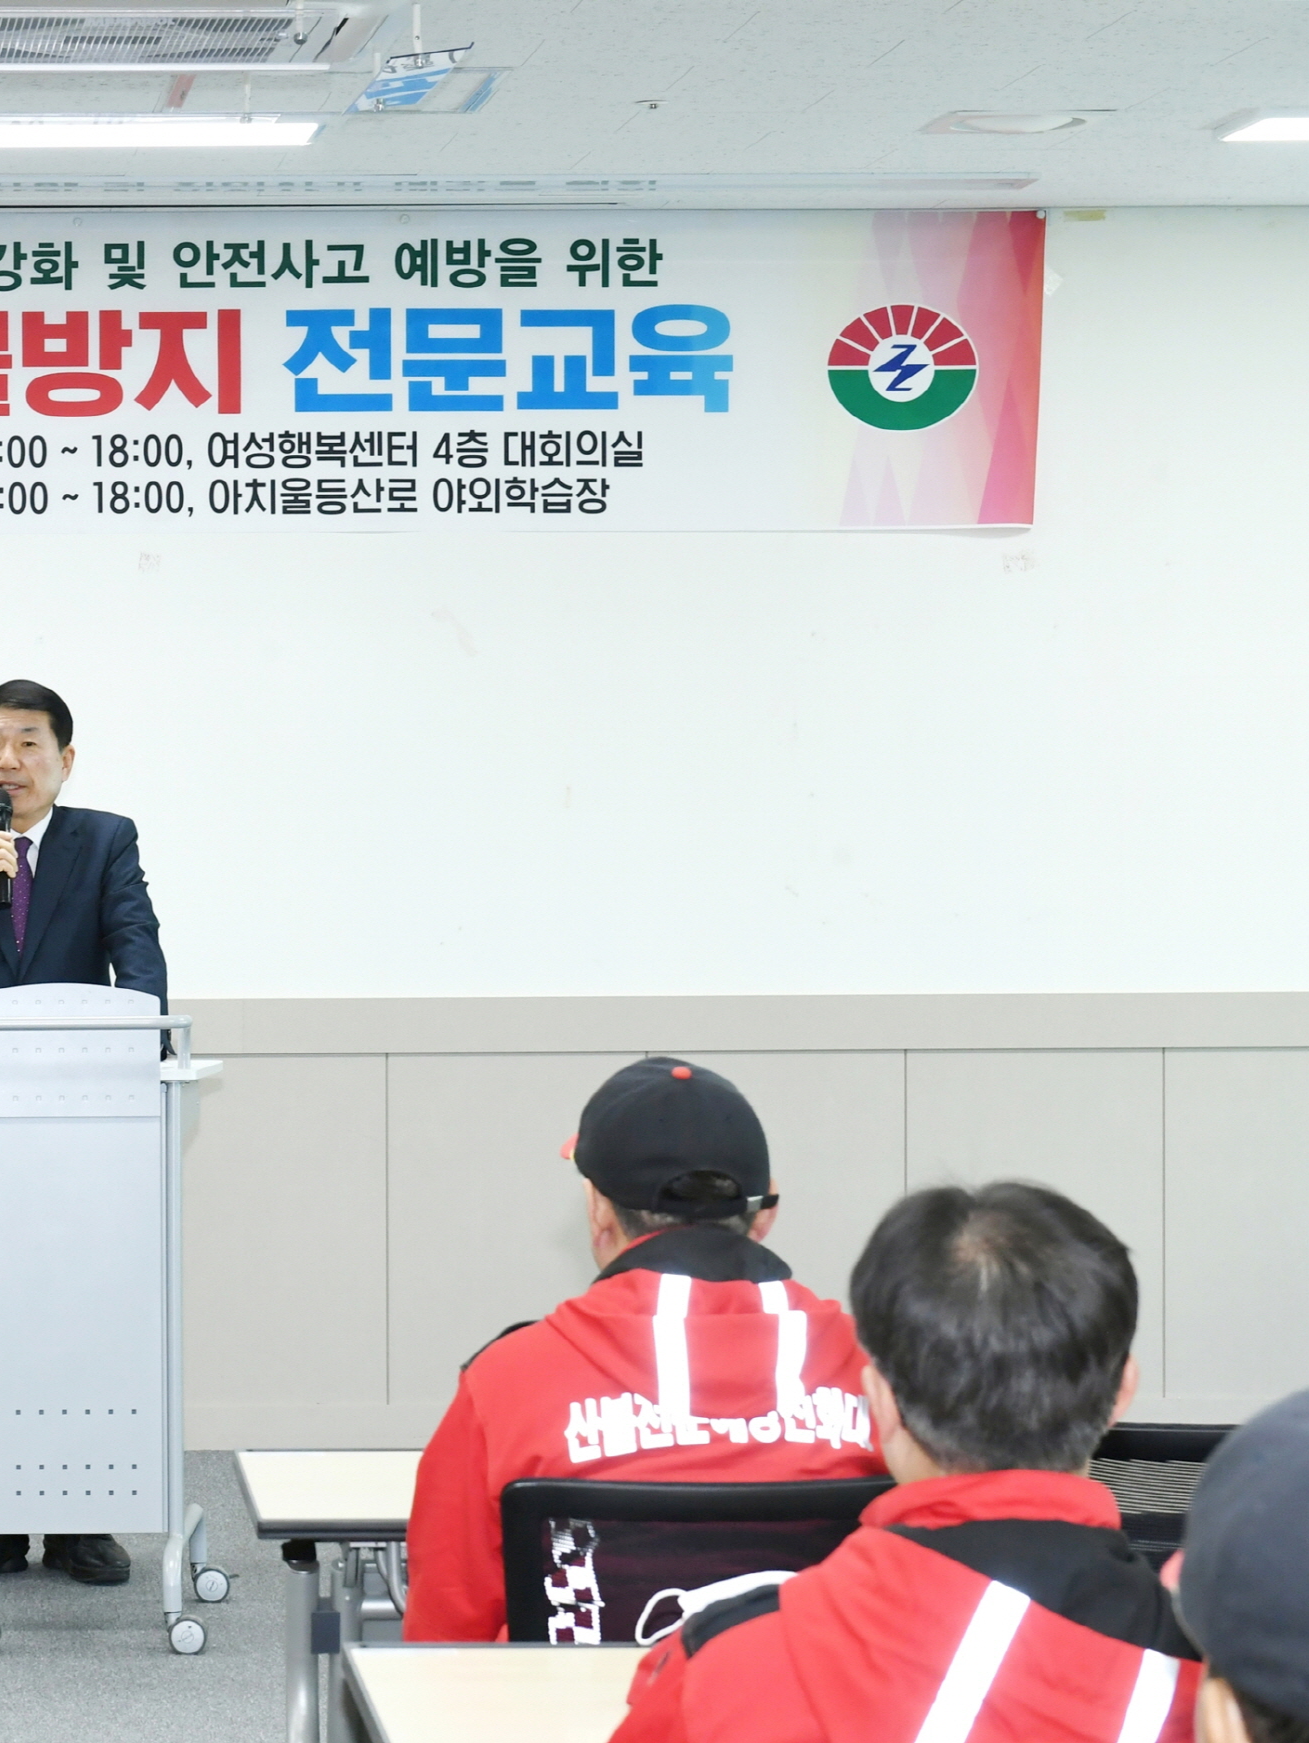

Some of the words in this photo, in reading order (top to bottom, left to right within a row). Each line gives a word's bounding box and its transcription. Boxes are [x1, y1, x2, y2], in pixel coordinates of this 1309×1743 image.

[104, 241, 146, 290] 및
[173, 240, 369, 288] 안전사고
[395, 238, 542, 288] 예방을
[566, 238, 663, 287] 위한
[283, 304, 733, 412] 전문교육
[92, 434, 192, 469] 18:00,
[208, 431, 417, 468] 여성행복센터
[433, 430, 488, 468] 4층
[504, 430, 643, 467] 대회의실
[93, 481, 193, 516] 18:00,
[209, 478, 417, 515] 아치울등산로
[433, 477, 609, 514] 야외학습장
